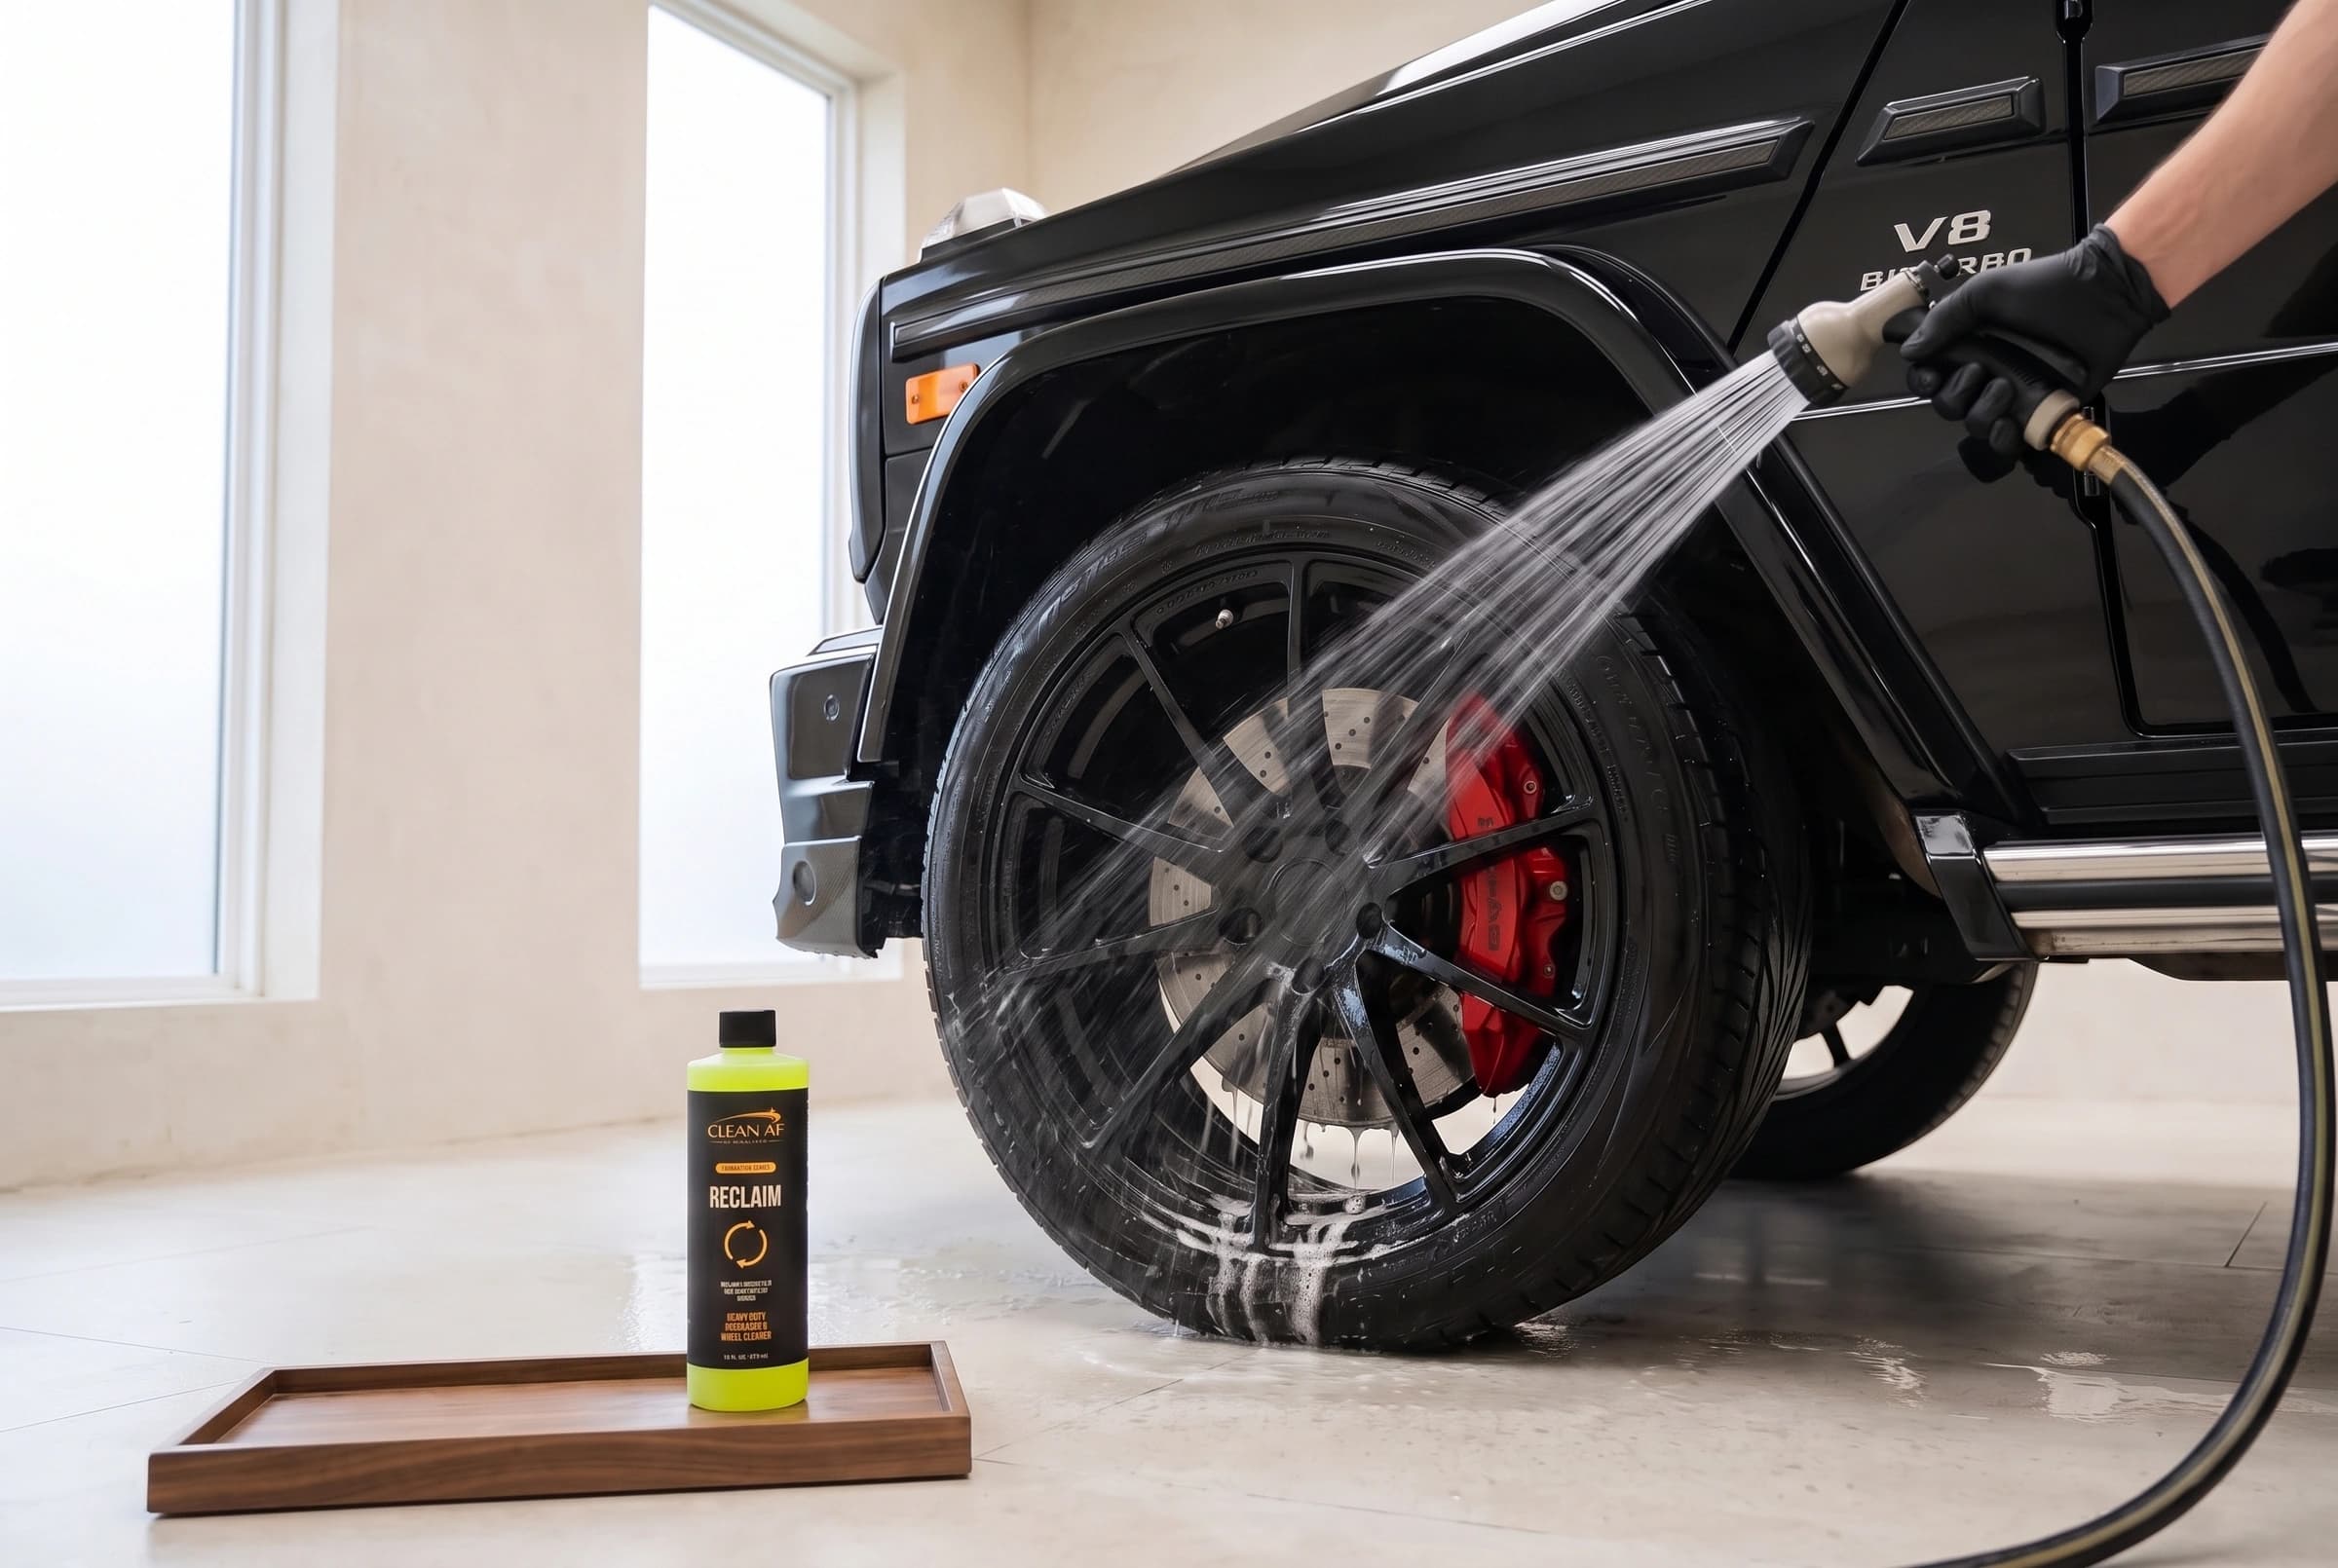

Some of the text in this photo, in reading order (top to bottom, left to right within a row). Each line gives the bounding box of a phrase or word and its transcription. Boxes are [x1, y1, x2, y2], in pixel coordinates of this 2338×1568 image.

[1894, 209, 1991, 253] V8
[1860, 247, 2032, 292] BIRBO
[707, 1123, 785, 1139] CLEAN AF
[709, 1184, 781, 1209] RECLAIM
[720, 1332, 742, 1341] WHEEL
